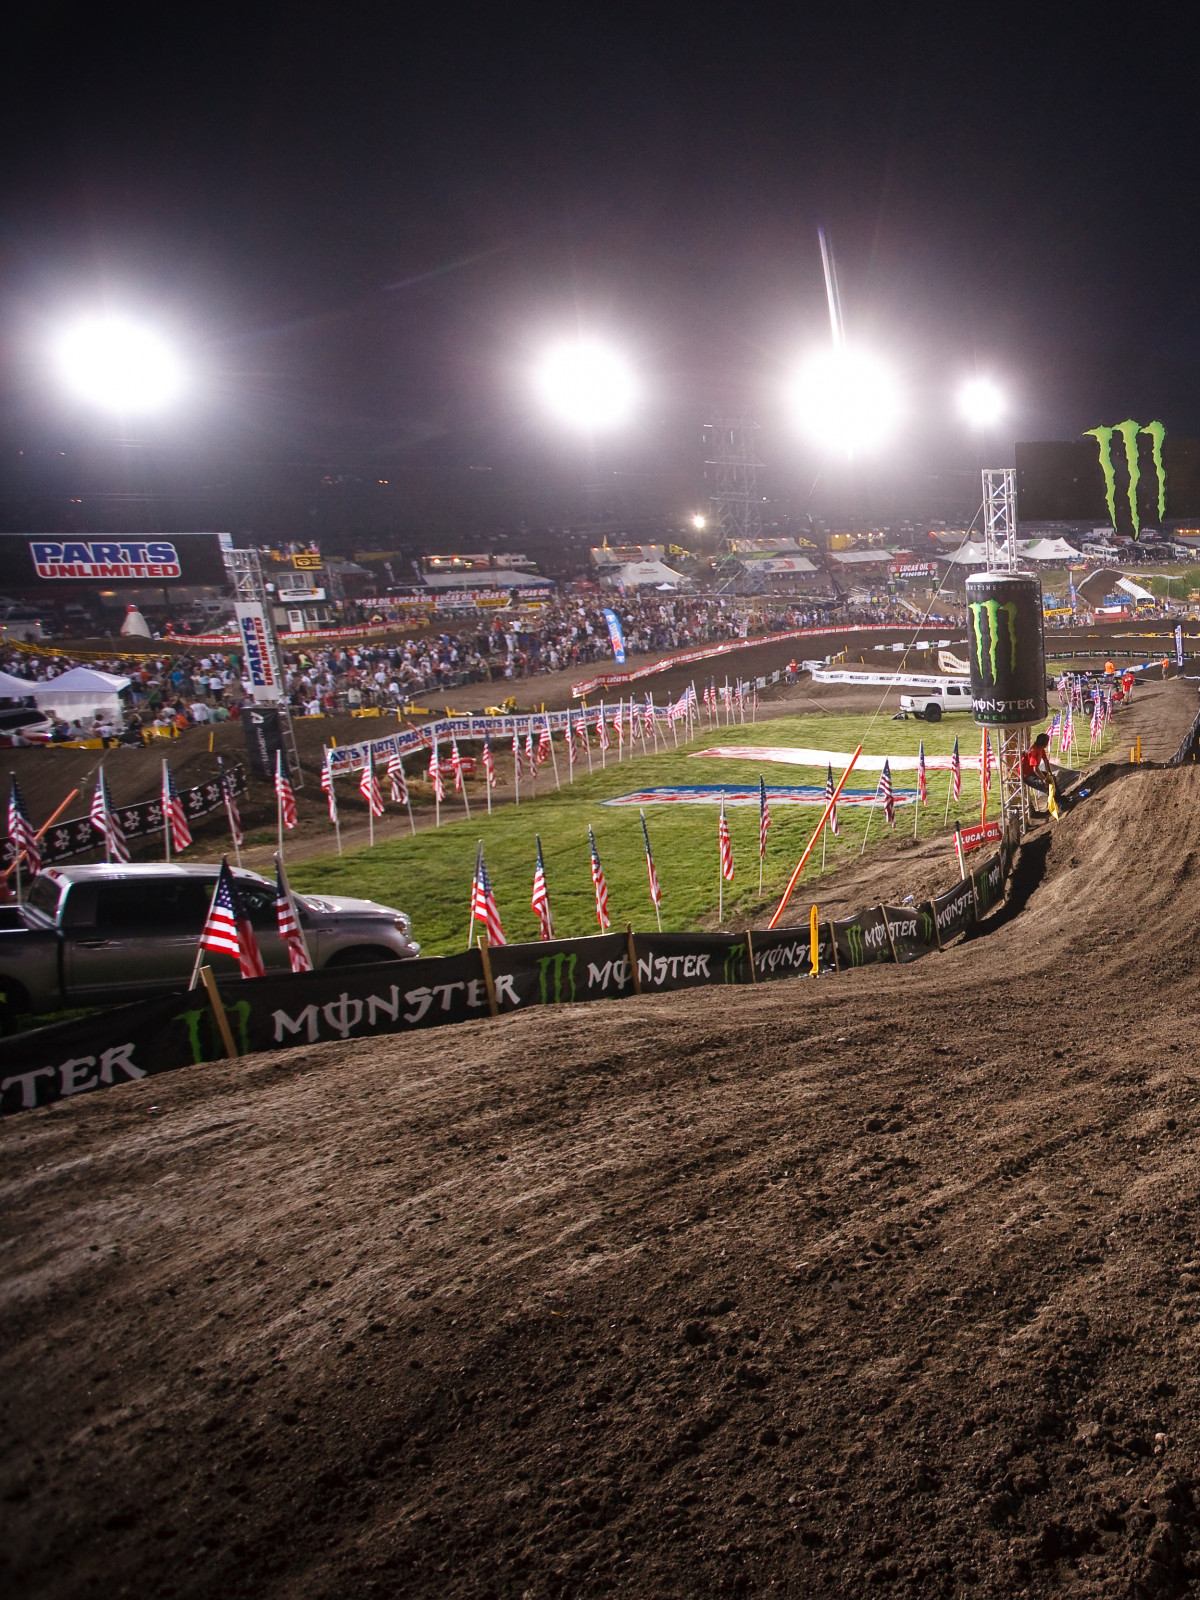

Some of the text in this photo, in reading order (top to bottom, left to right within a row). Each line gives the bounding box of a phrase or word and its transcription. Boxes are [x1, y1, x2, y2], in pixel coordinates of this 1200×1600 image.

[31, 543, 177, 564] PARTS
[38, 564, 181, 577] UNLIMITED
[900, 564, 919, 572] LUCAS
[242, 617, 266, 686] PARTS
[254, 617, 274, 686] UNLIMITED
[972, 698, 1036, 714] MONSTER
[435, 719, 470, 734] PARTS
[472, 718, 502, 730] PARTS
[961, 828, 1000, 845] LUCAS OIL
[271, 973, 521, 1043] MONSTER
